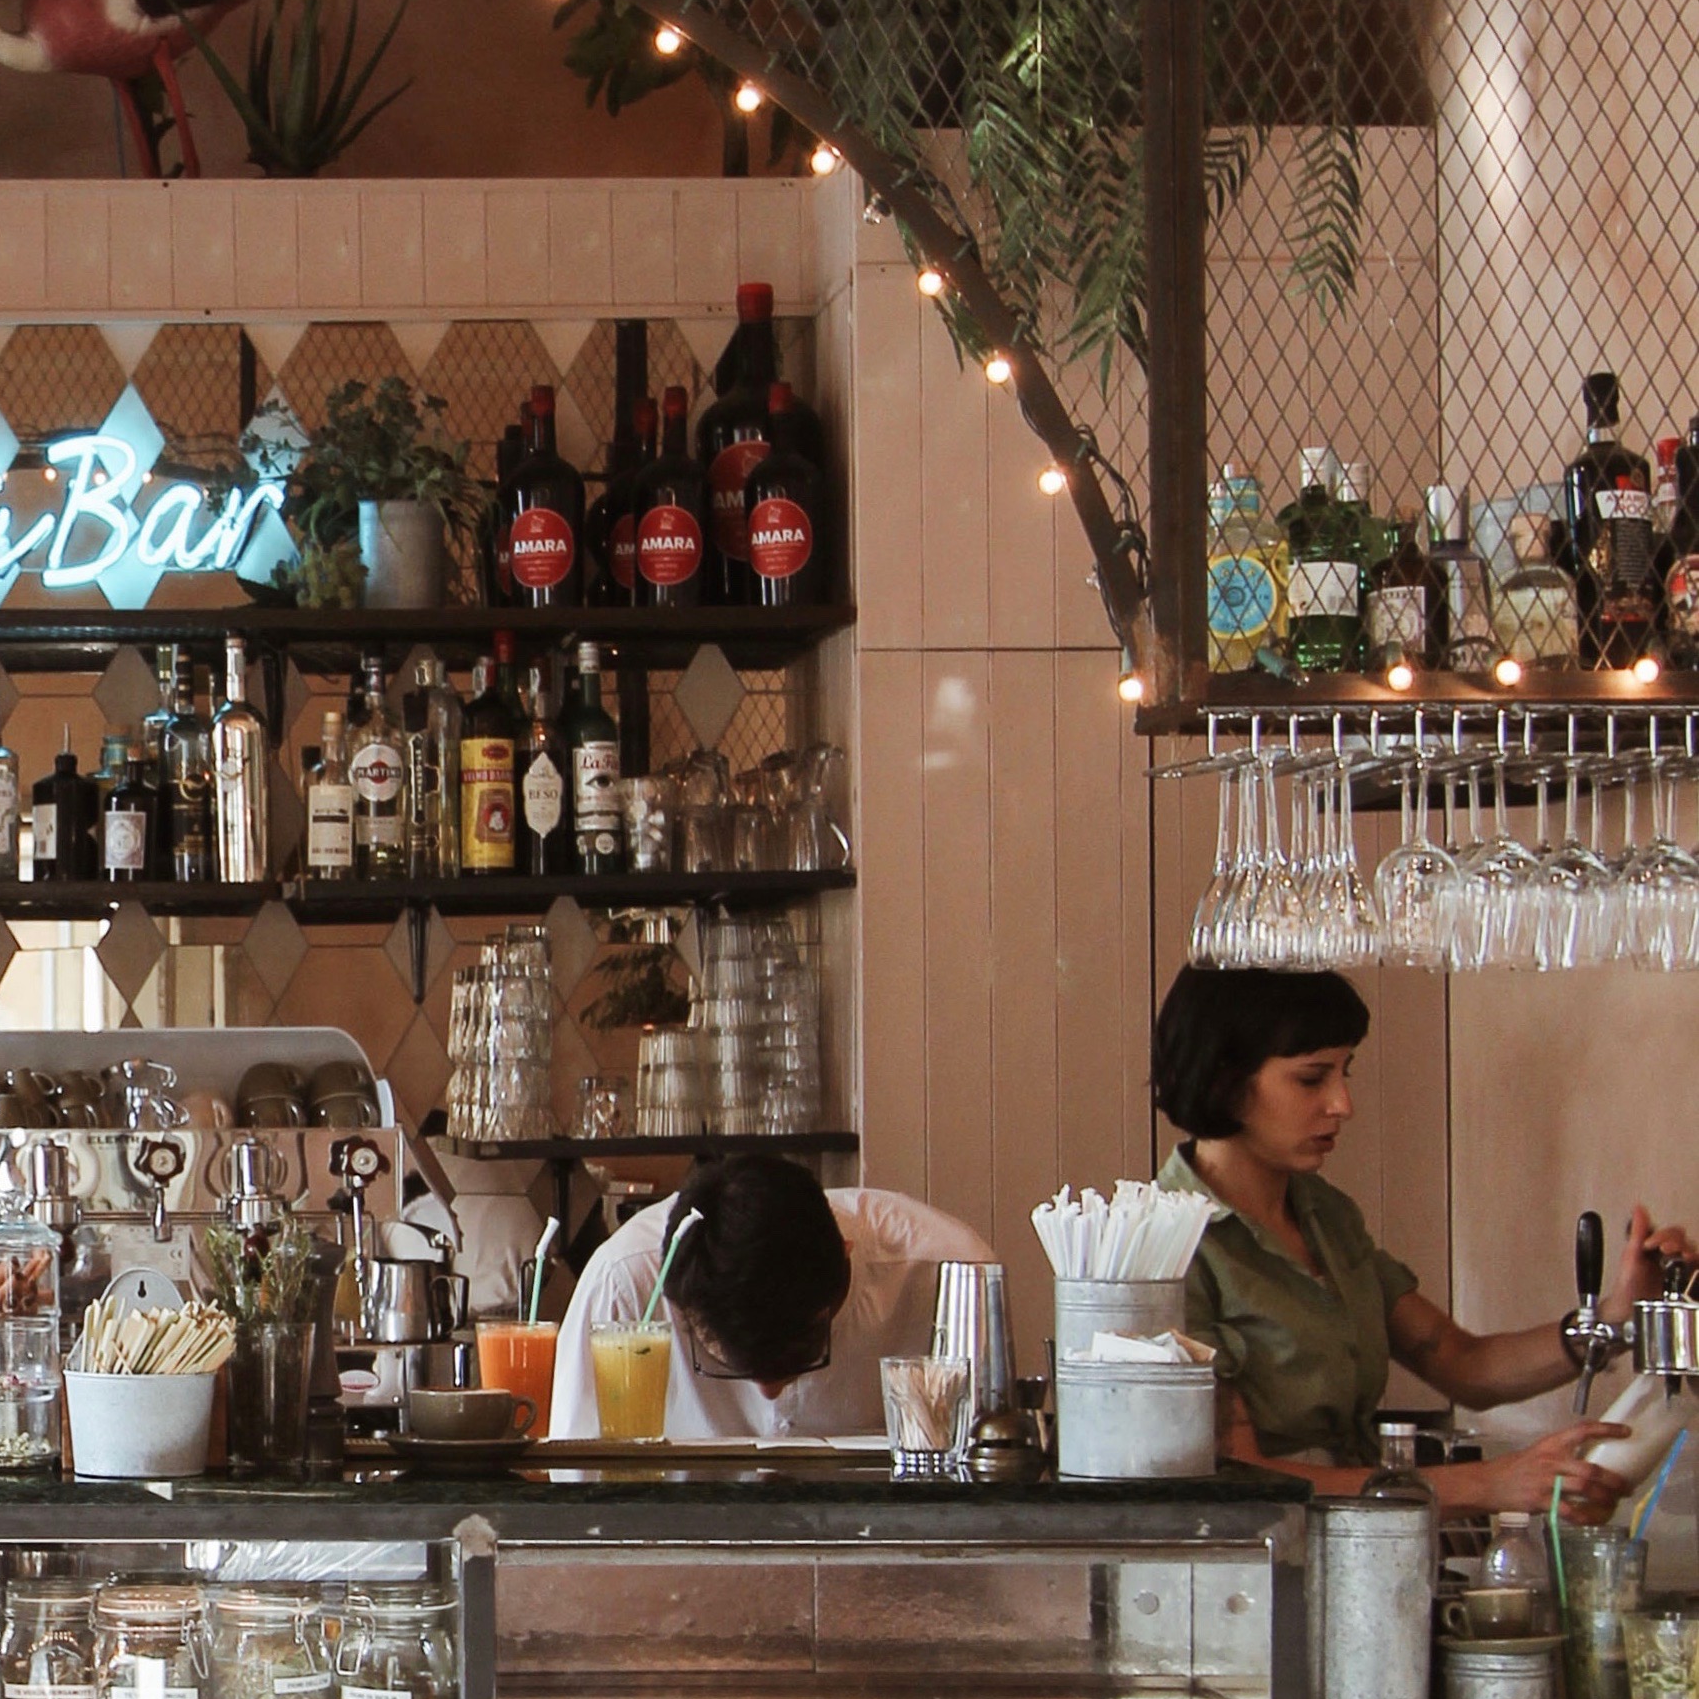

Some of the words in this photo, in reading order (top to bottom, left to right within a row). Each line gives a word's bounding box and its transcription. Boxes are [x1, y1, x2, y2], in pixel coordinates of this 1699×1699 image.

[641, 537, 696, 551] AMARA
[750, 529, 805, 546] AMARA
[513, 539, 568, 555] AMARA
[355, 766, 401, 779] MARTINI
